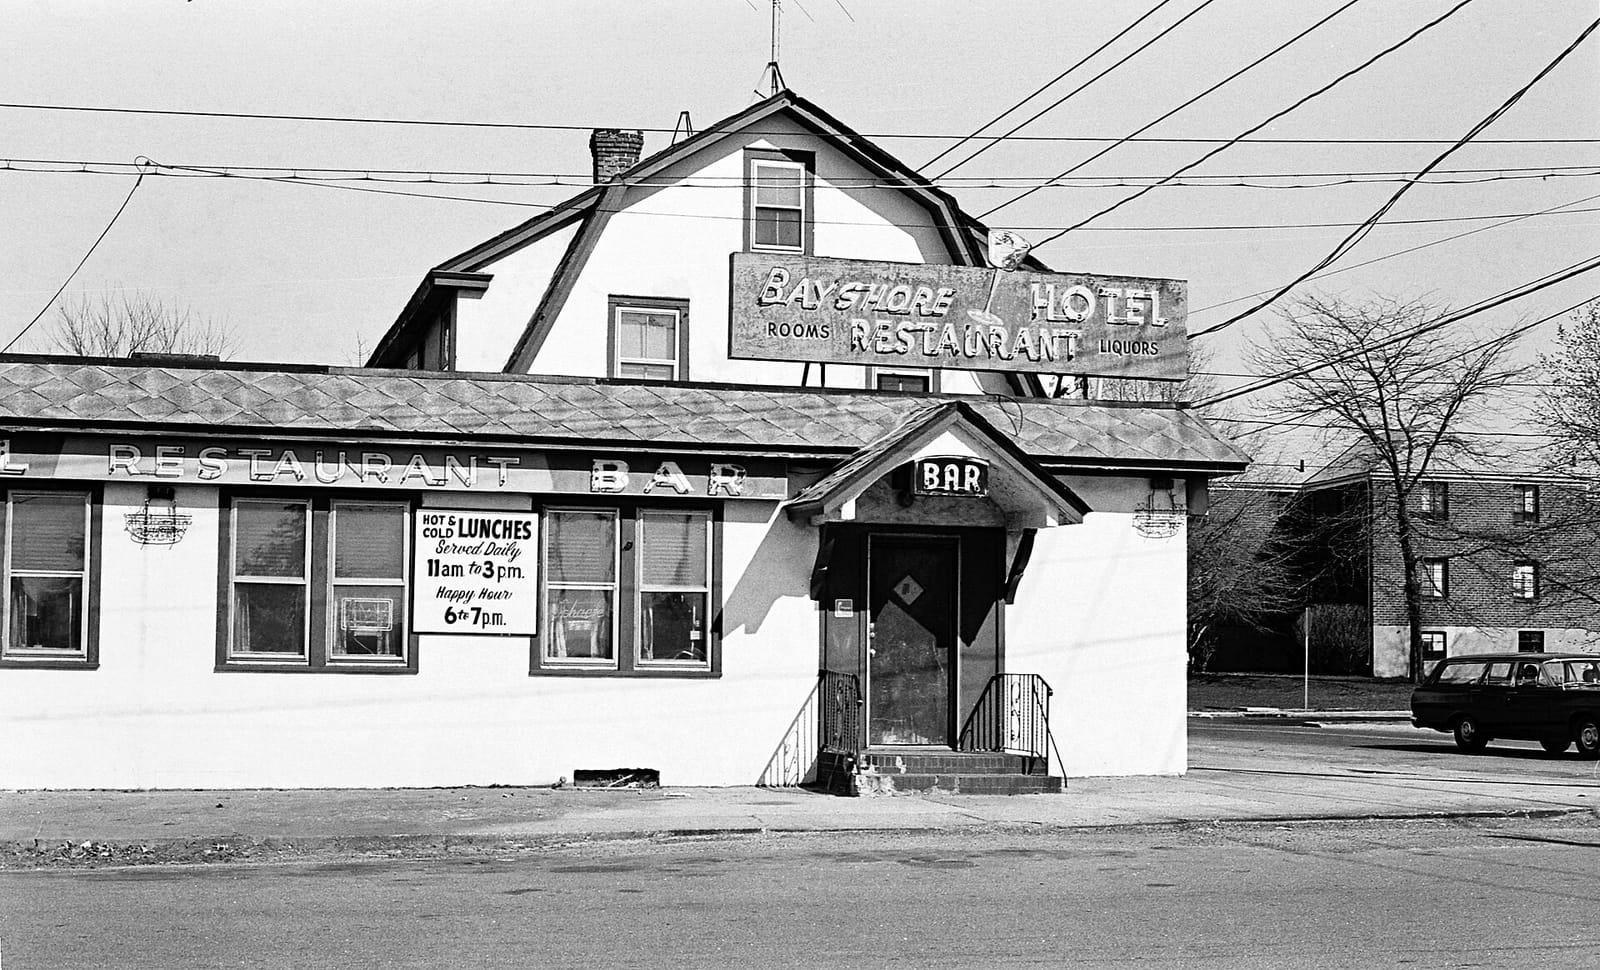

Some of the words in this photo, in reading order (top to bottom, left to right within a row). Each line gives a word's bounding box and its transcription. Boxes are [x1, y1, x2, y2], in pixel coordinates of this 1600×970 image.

[1031, 281, 1169, 328] HOTEL
[767, 322, 830, 339] ROOMS
[850, 318, 1083, 363] RESTAURANT
[1099, 339, 1159, 358] LIQUORS
[108, 443, 520, 488] RESTAURANT
[590, 459, 747, 496] BAR
[922, 462, 981, 492] BAR
[423, 514, 446, 526] HOT
[448, 515, 457, 526] &
[458, 517, 532, 540] LUNCHES
[423, 527, 454, 539] COLD
[435, 539, 485, 555] Served
[483, 541, 522, 563] Daily
[468, 560, 482, 575] to
[436, 586, 476, 605] Happy
[478, 587, 513, 600] Hour
